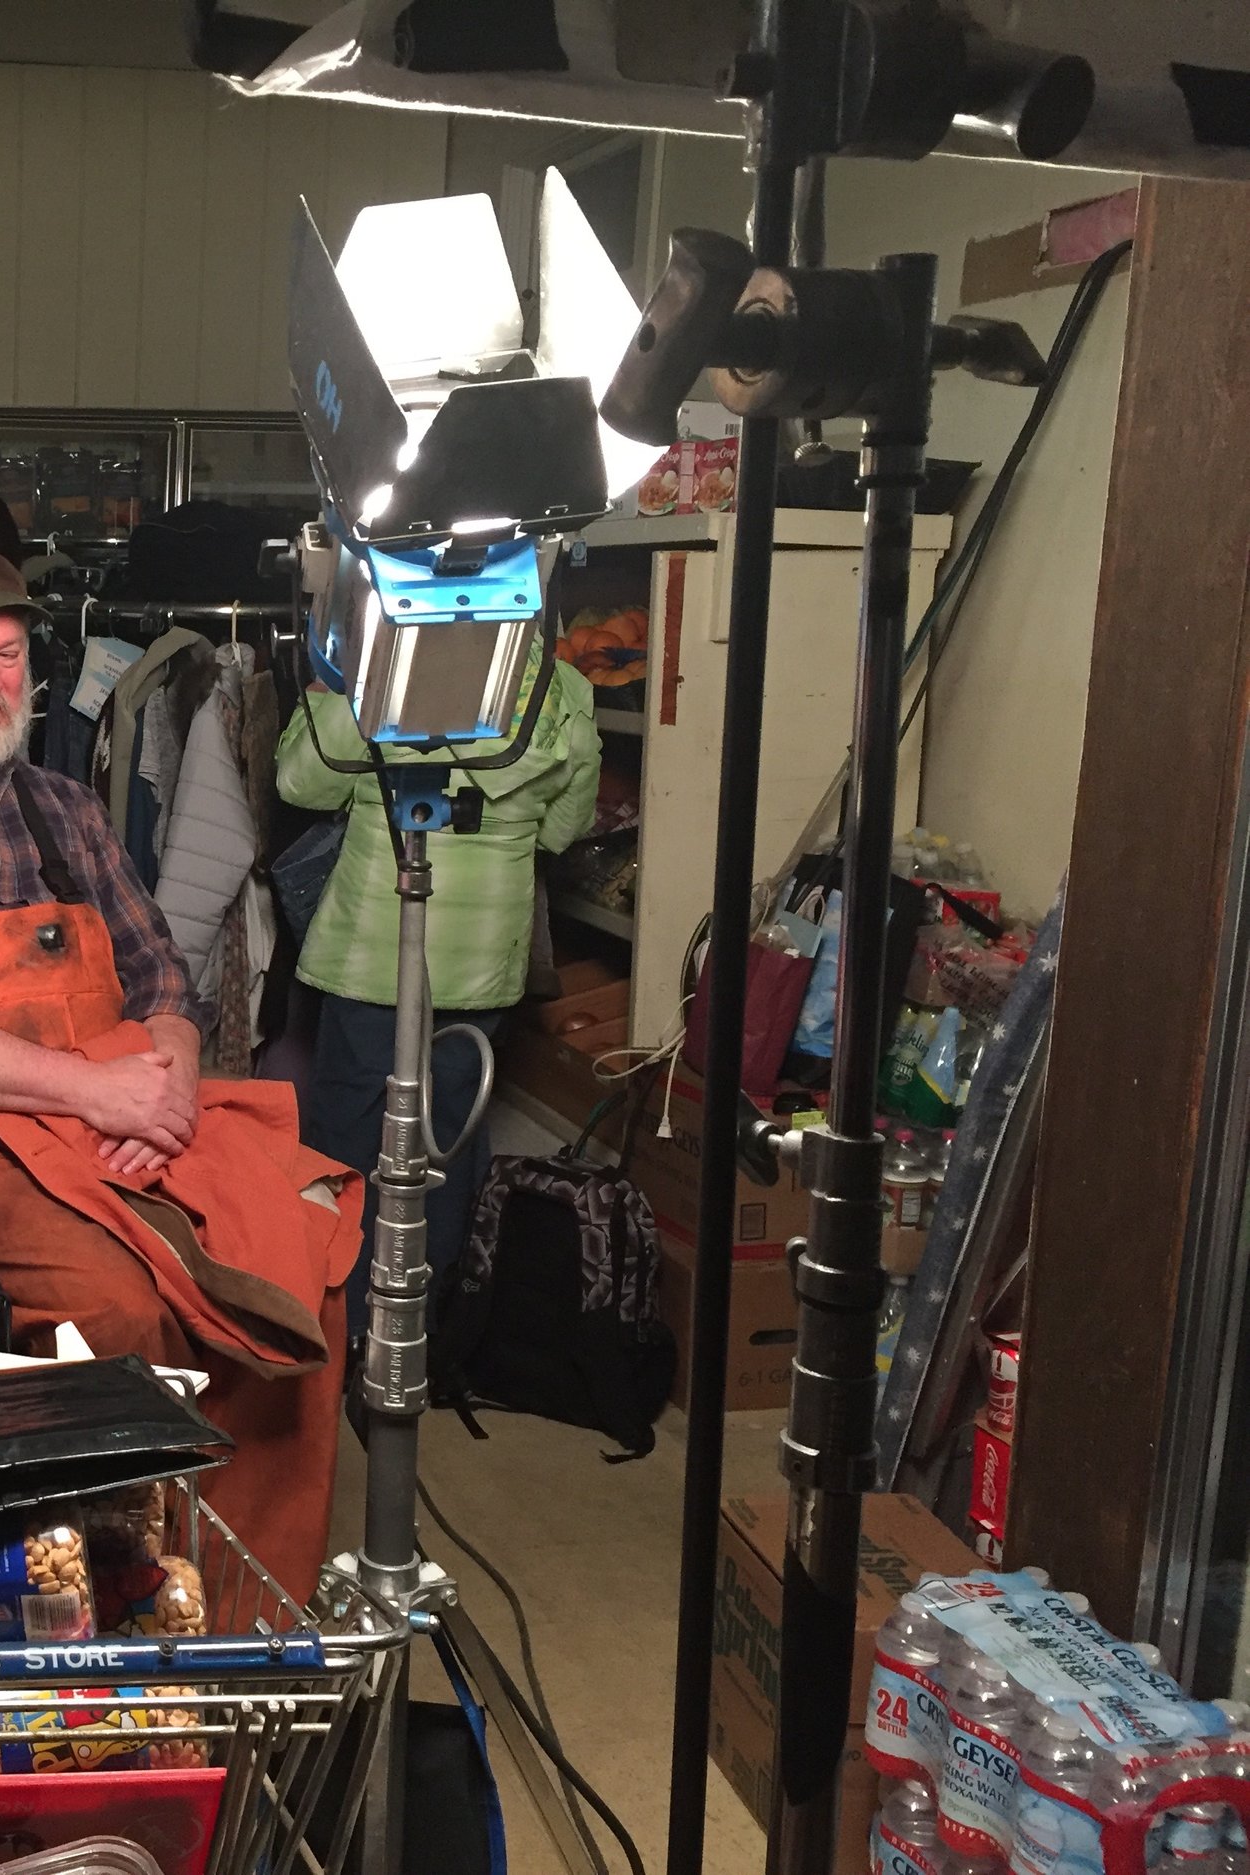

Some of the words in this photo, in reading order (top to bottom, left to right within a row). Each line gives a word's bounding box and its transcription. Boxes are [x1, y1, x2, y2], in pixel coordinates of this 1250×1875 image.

[391, 1226, 406, 1283] AMERICAN
[389, 1345, 403, 1404] AMERICAN
[25, 1643, 125, 1670] STORE
[875, 1687, 910, 1729] 24
[876, 1718, 908, 1741] BOTTLES
[956, 1714, 982, 1736] THE
[990, 1731, 1022, 1762] SOUR
[976, 1779, 1010, 1808] WATE
